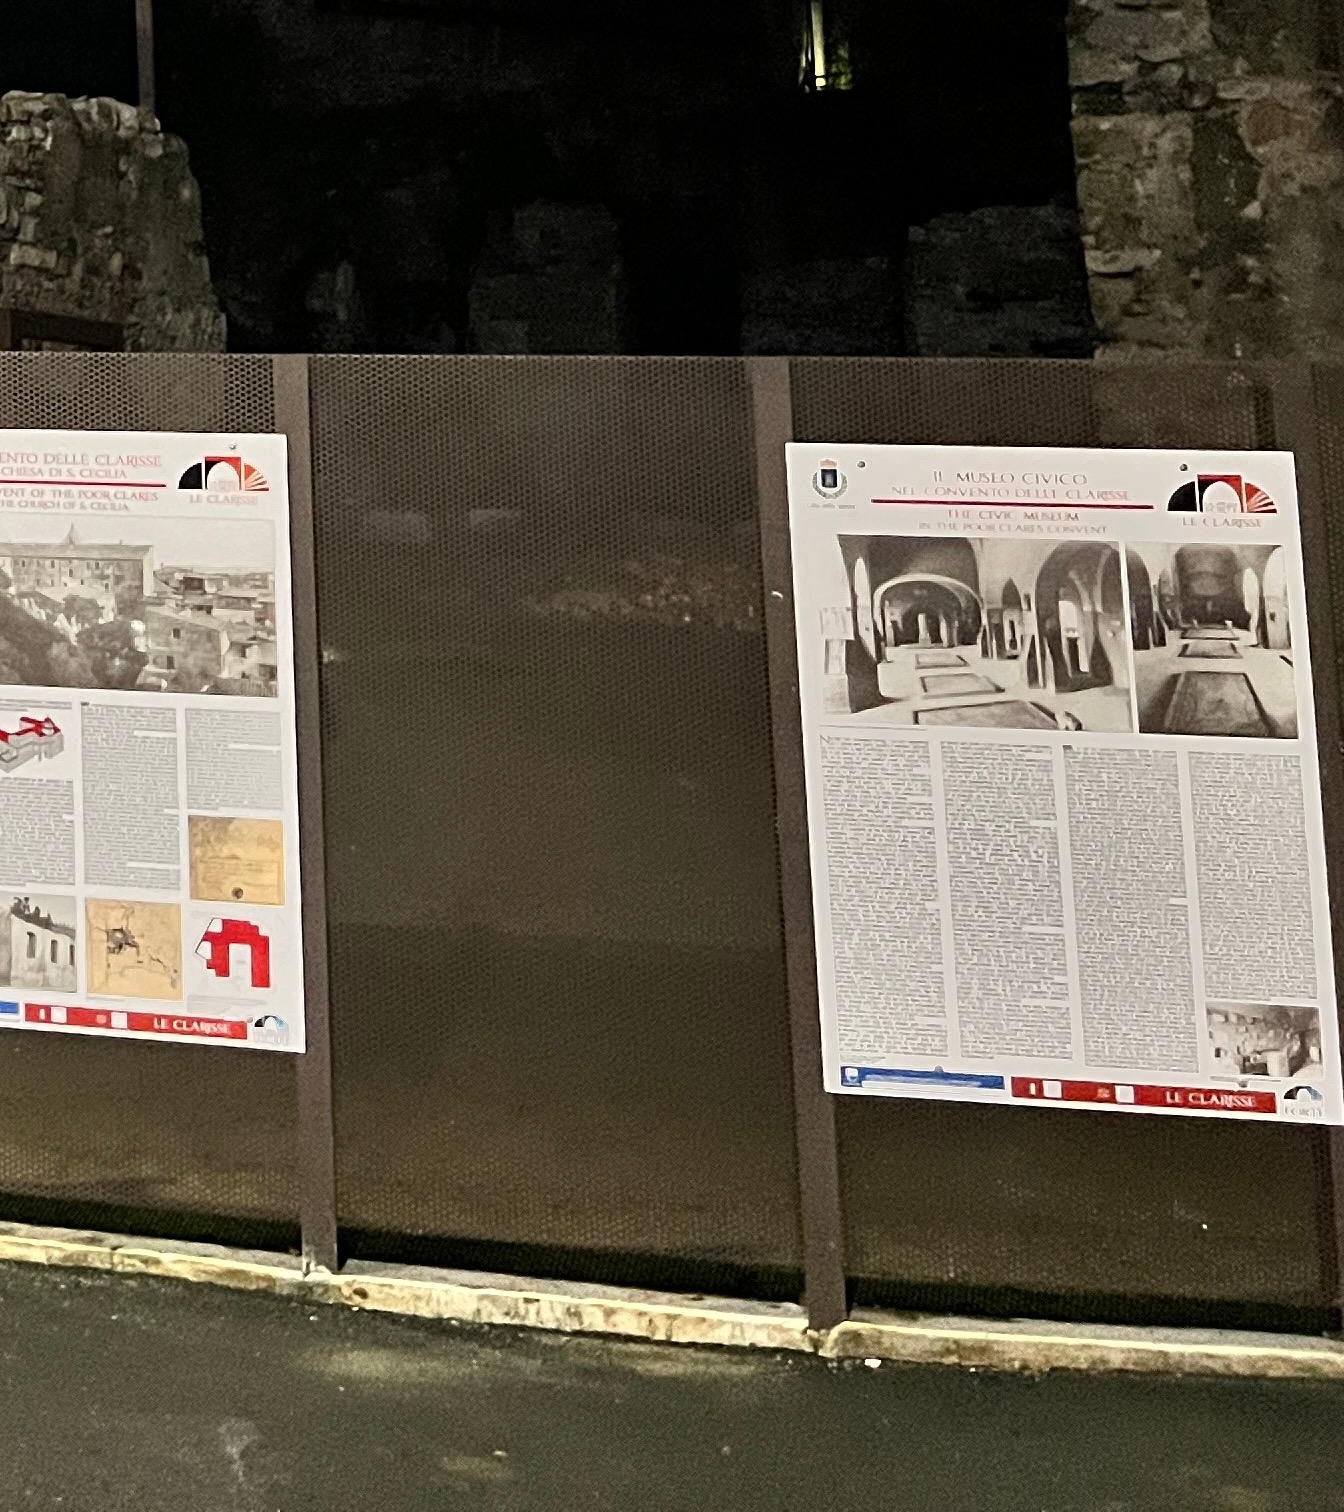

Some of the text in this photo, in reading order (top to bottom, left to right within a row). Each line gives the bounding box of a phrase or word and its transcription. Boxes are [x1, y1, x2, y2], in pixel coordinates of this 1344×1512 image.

[44, 453, 91, 466] DELLE
[95, 454, 162, 467] CLARISSE
[49, 468, 63, 477] DI
[956, 472, 1015, 484] MUSEO
[1022, 473, 1088, 485] CIVICO
[31, 488, 45, 498] OF
[78, 489, 112, 500] POOR
[113, 490, 159, 501] CLARES
[924, 486, 1010, 497] CONVENTO
[979, 510, 1015, 520] CIVIC
[1024, 511, 1080, 522] MUSEUM
[153, 1017, 231, 1034] LE CLARISSE
[1165, 1090, 1256, 1108] LE CLARISSE
